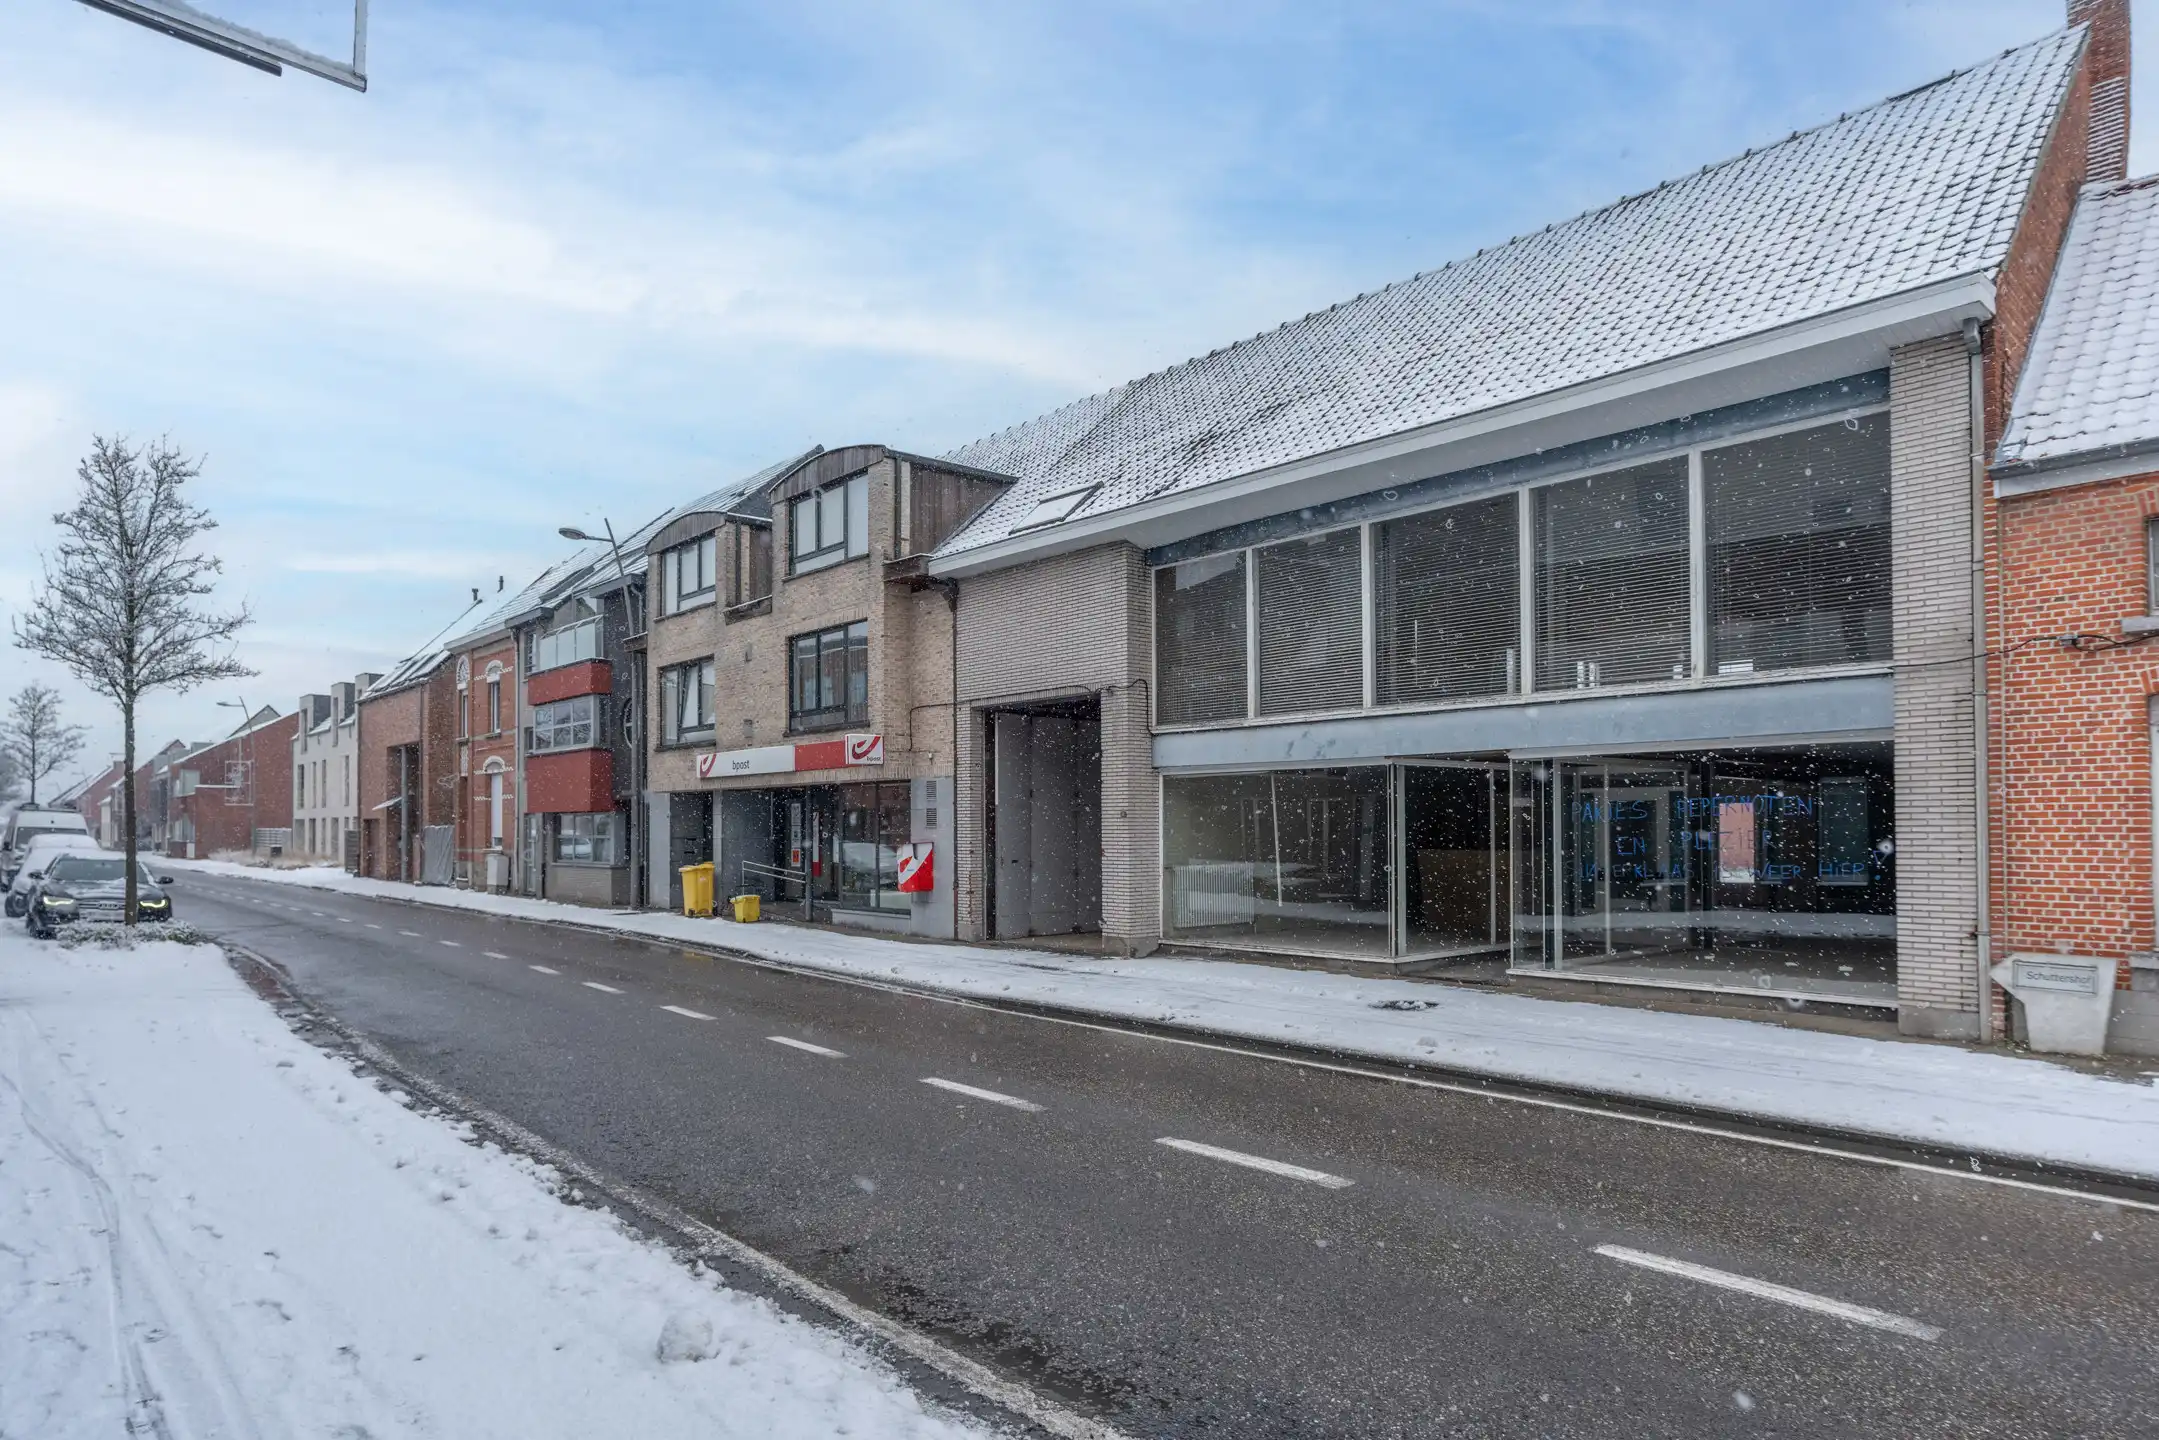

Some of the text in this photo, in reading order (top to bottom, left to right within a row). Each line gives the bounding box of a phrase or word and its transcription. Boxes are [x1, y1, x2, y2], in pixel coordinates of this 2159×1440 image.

[732, 760, 750, 773] bpost
[1616, 835, 1646, 857] EN
[1746, 862, 1804, 881] WEER
[1817, 861, 1865, 881] HIER
